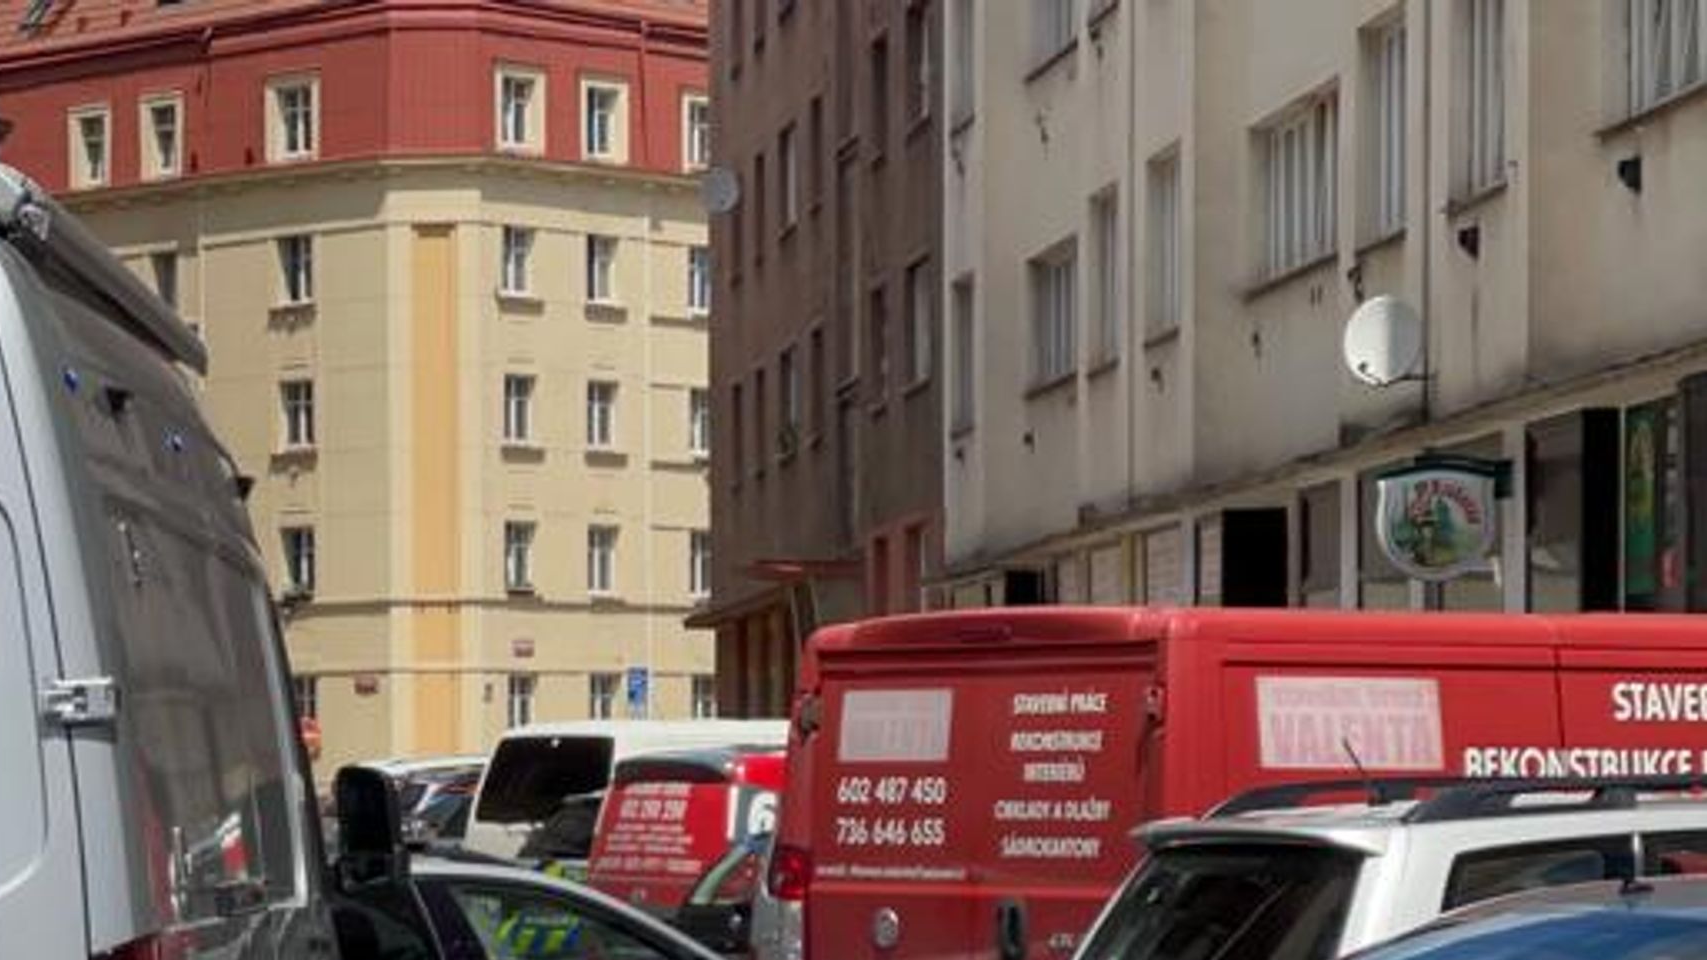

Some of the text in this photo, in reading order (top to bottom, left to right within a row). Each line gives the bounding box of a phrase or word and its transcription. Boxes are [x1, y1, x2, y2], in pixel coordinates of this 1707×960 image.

[838, 776, 947, 805] 602 487 450
[837, 817, 945, 847] 736 646 655
